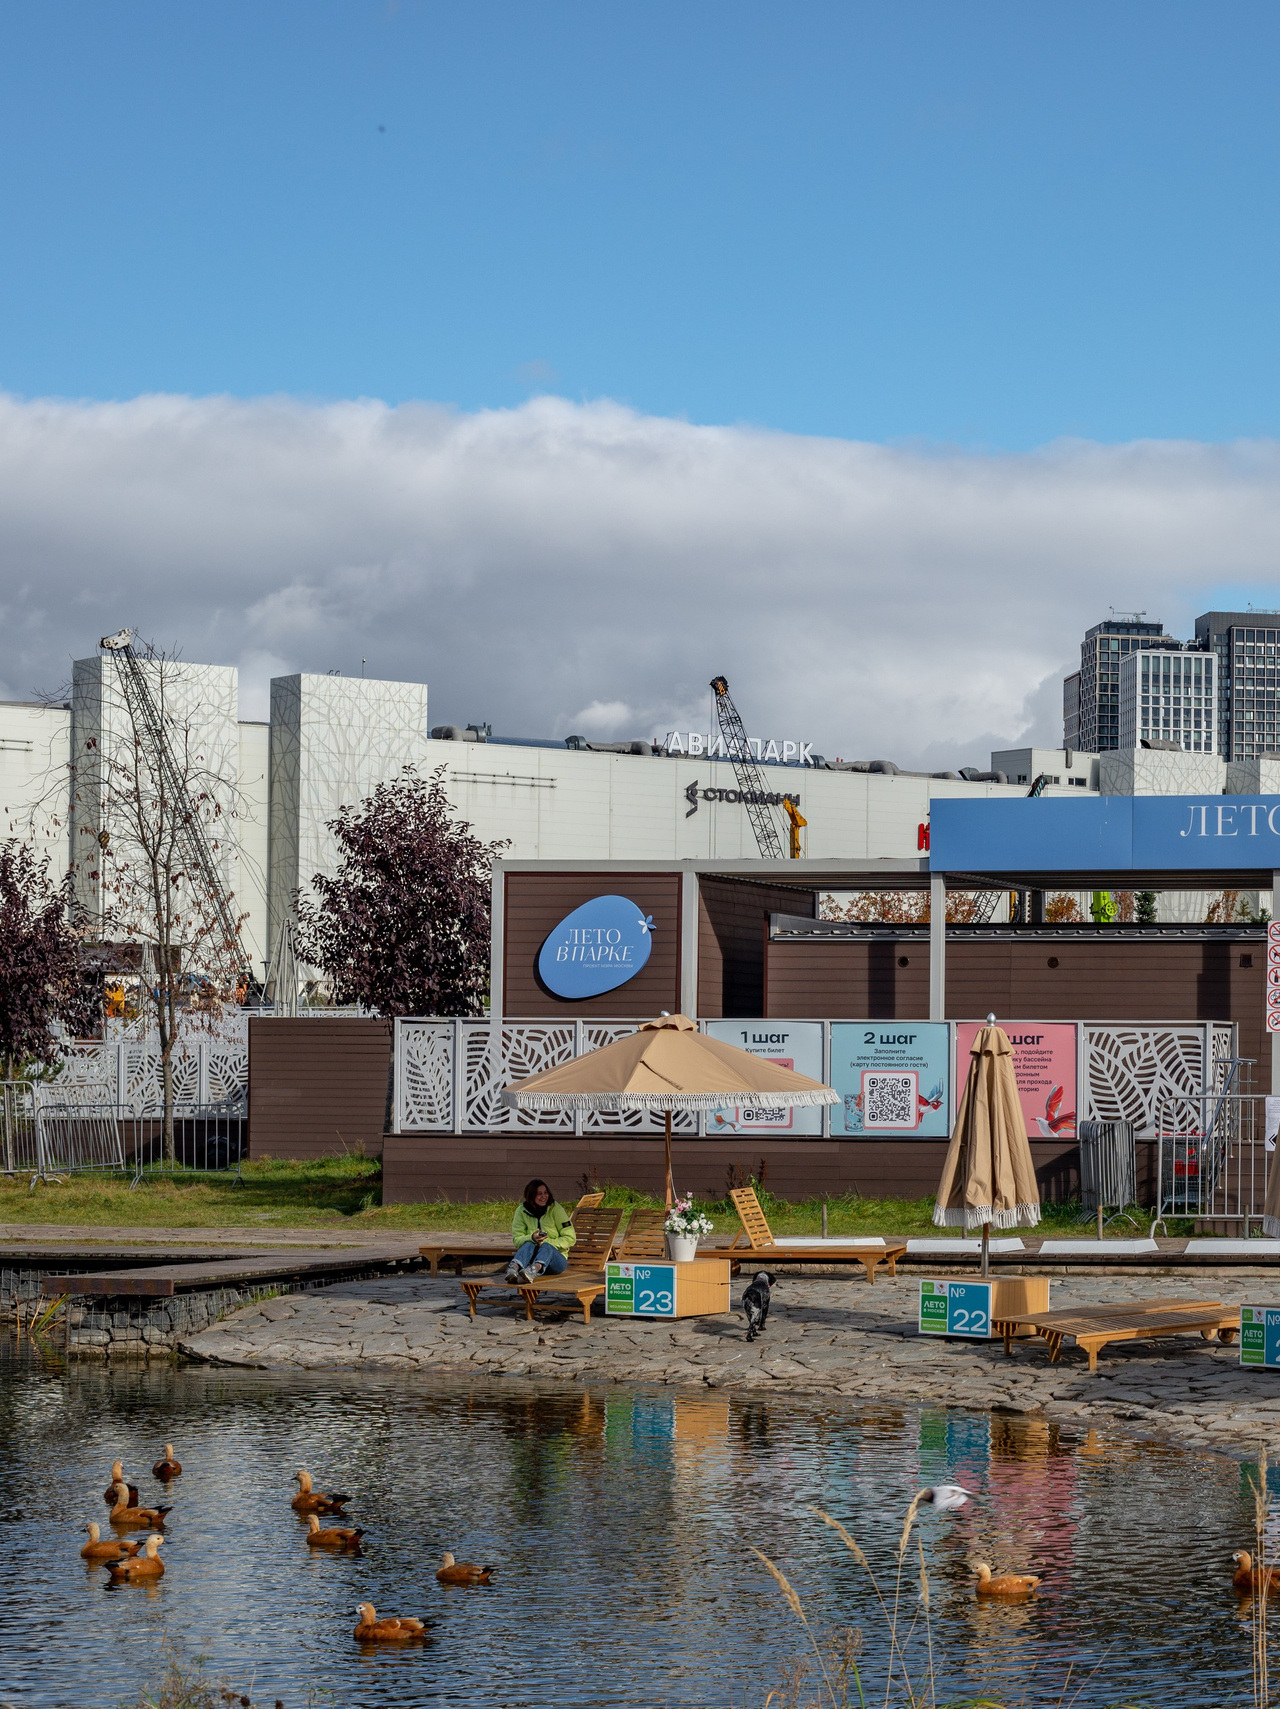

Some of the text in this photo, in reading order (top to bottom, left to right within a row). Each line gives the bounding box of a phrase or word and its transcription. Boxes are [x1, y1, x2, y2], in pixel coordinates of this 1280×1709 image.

[668, 731, 814, 765] АВИАПАРК
[565, 928, 621, 945] ЛЕТО
[556, 945, 634, 961] В ПАРКЕ
[740, 1031, 789, 1044] 1 шаг
[863, 1032, 917, 1045] 2 шаг
[639, 1290, 672, 1312] 23
[923, 1300, 945, 1309] ЛЕТО
[953, 1309, 987, 1332] 22
[1244, 1329, 1263, 1337] ЛЕТО
